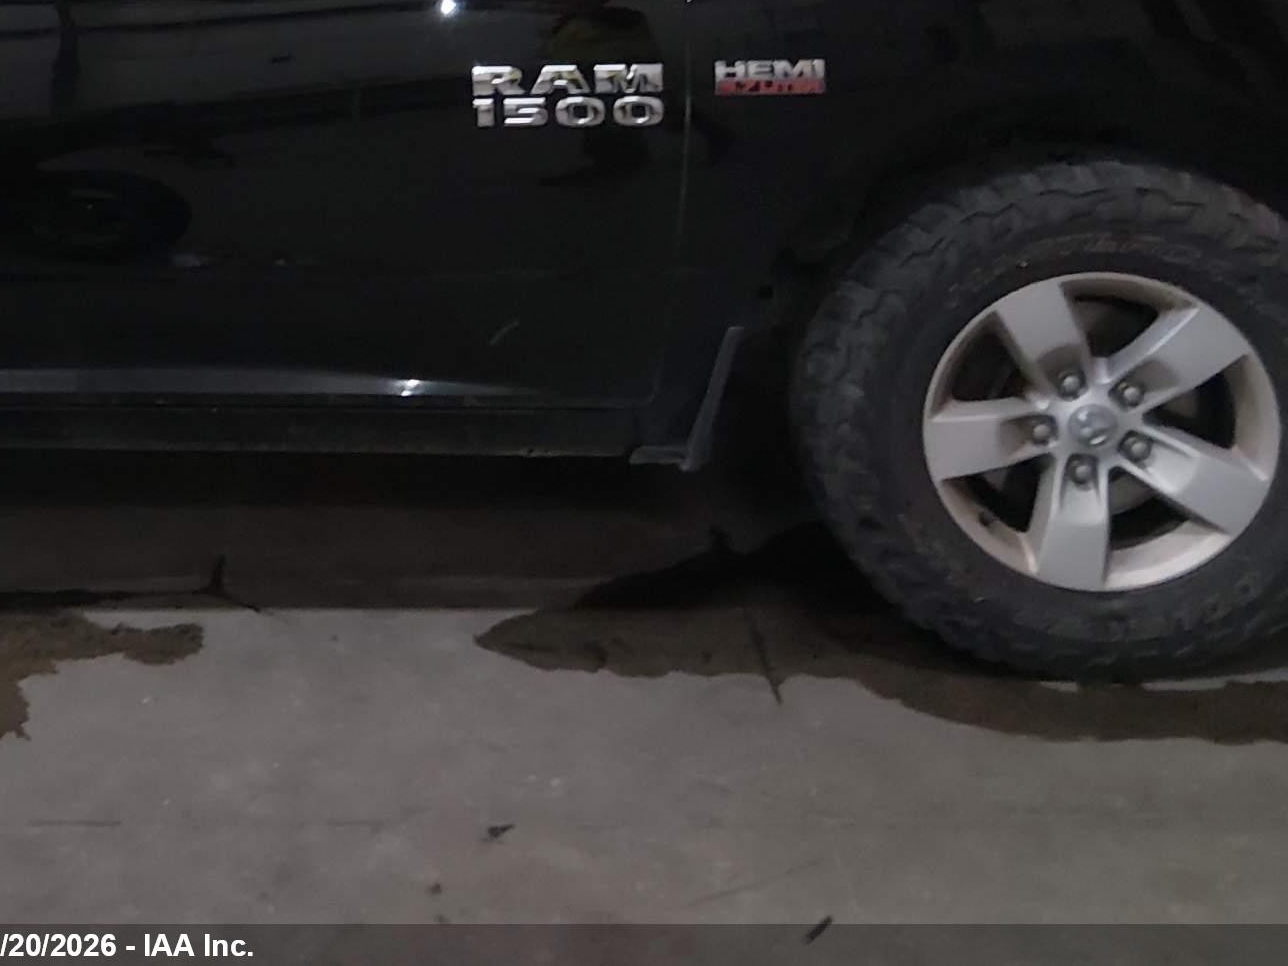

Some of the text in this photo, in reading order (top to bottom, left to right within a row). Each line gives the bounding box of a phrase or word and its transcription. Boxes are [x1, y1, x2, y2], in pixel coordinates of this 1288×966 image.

[471, 62, 664, 95] RAM
[714, 59, 826, 80] HEMI
[472, 95, 664, 128] 1500
